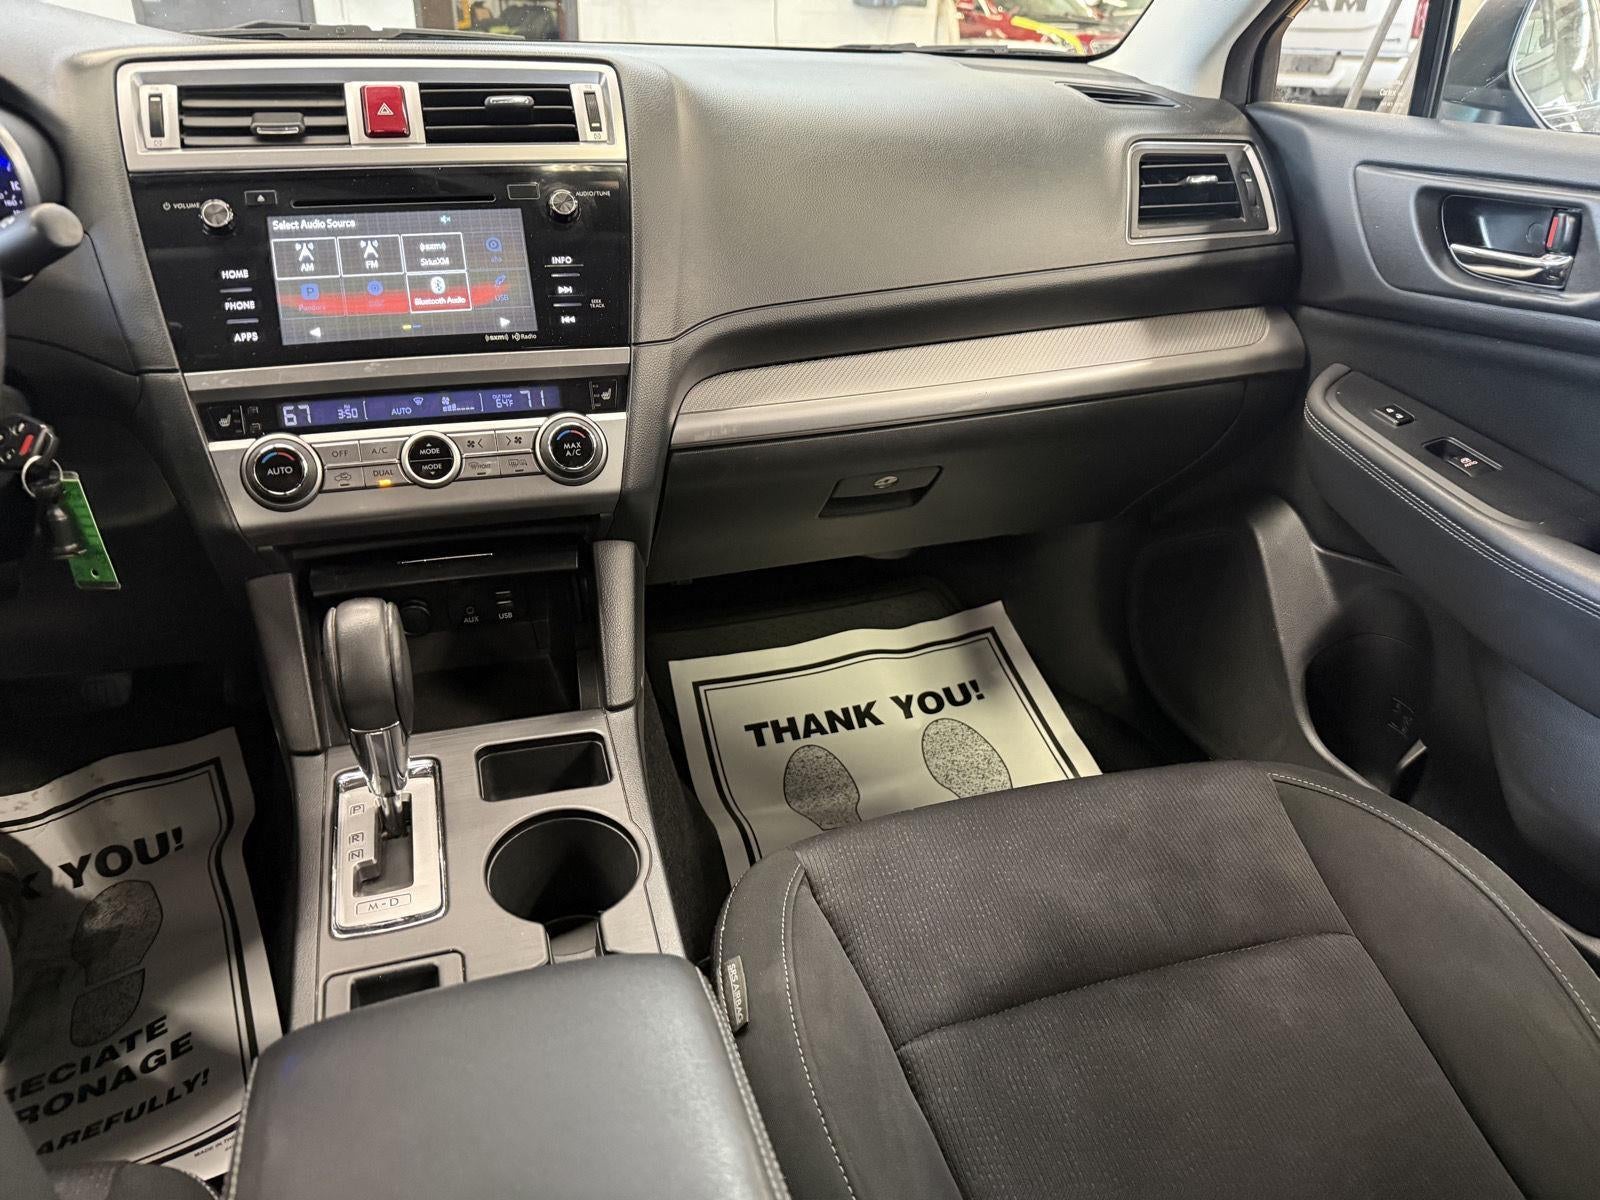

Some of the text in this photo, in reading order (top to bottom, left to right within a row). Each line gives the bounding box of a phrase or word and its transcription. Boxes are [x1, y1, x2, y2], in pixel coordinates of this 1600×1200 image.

[272, 218, 356, 231] Select Audio Source
[366, 260, 379, 269] FM
[420, 257, 450, 266] SiriusXM
[551, 256, 573, 264] INFO
[300, 263, 315, 272] AM
[221, 269, 250, 280] HOME
[414, 296, 466, 305] Bluetooth Audio
[224, 300, 256, 311] PHONE
[234, 332, 258, 343] APPS
[520, 390, 545, 408] 71
[283, 404, 311, 426] 67
[338, 408, 358, 419] 3:50
[391, 407, 412, 416] AUTO
[371, 446, 388, 455] A/C
[564, 442, 582, 450] MAX
[331, 450, 349, 458] OFF
[565, 449, 581, 457] A/C
[266, 466, 293, 476] AUTO
[421, 463, 443, 471] MODE
[744, 679, 985, 748] THANK YOU!
[352, 804, 362, 815] P
[351, 834, 360, 843] R
[59, 826, 184, 889] YOU!
[351, 851, 361, 860] N
[730, 963, 739, 982] SRS
[36, 1067, 211, 1156] AREFULLY!
